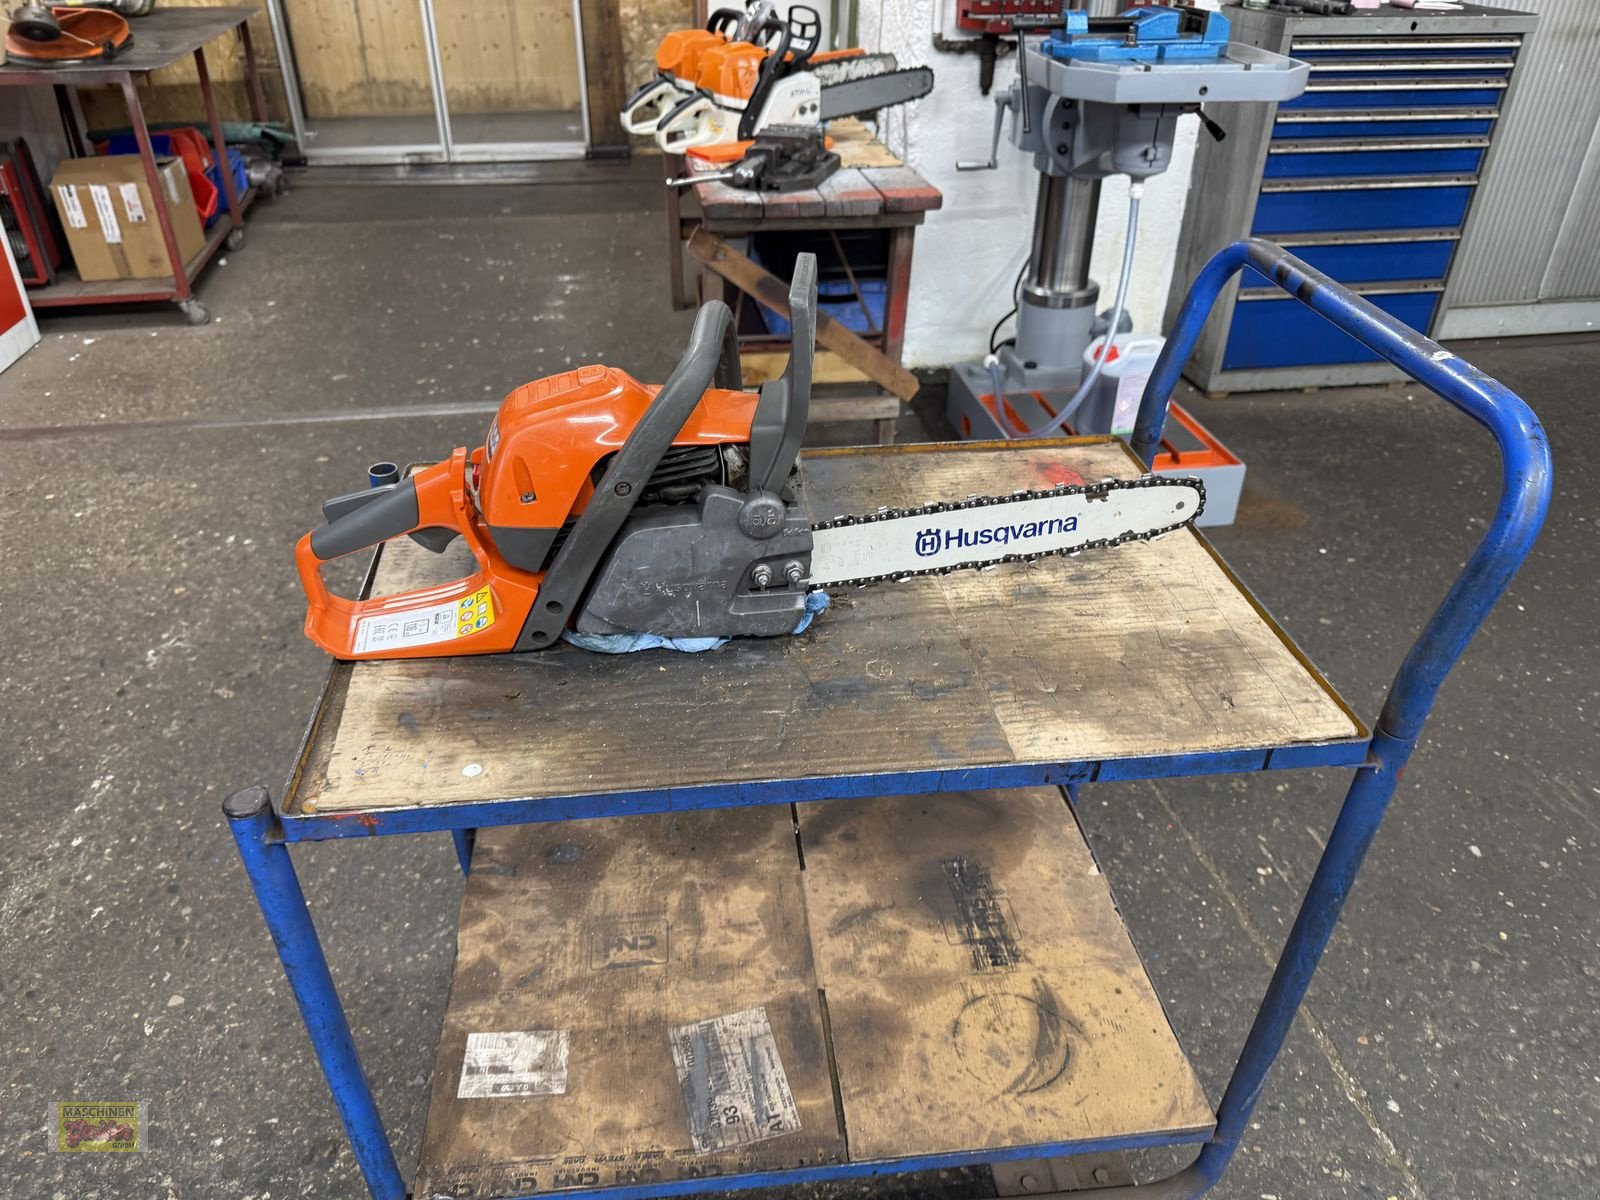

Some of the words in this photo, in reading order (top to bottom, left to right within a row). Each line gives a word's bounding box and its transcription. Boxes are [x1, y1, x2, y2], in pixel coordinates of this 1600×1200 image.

[945, 516, 1078, 549] Husqvarna
[723, 1105, 740, 1125] 93
[552, 1172, 600, 1188] CNH
